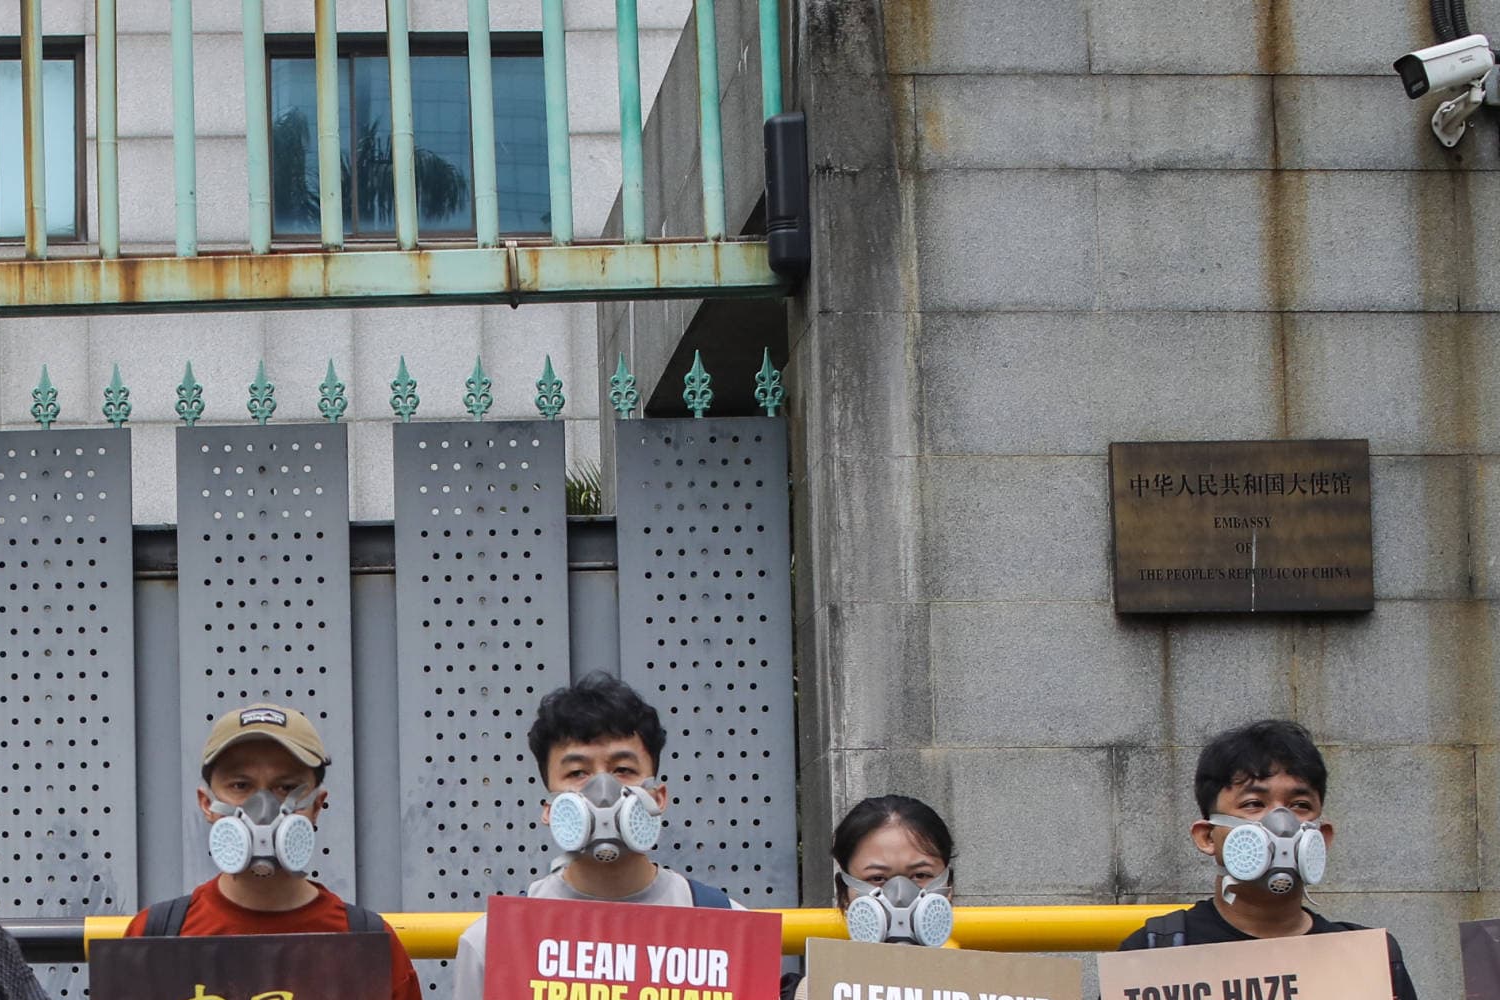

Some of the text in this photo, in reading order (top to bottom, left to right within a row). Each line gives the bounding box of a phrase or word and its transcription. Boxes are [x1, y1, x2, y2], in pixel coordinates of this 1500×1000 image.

[1129, 473, 1352, 497] 中华人民共和国大使馆
[1214, 516, 1272, 529] EMBASSY
[1236, 542, 1254, 554] OF
[1138, 569, 1162, 581] THE
[1166, 568, 1226, 580] PEOPLE'S
[1292, 567, 1308, 579] OF
[1312, 567, 1351, 579] CHINA
[537, 938, 729, 988] CLEAN YOUR
